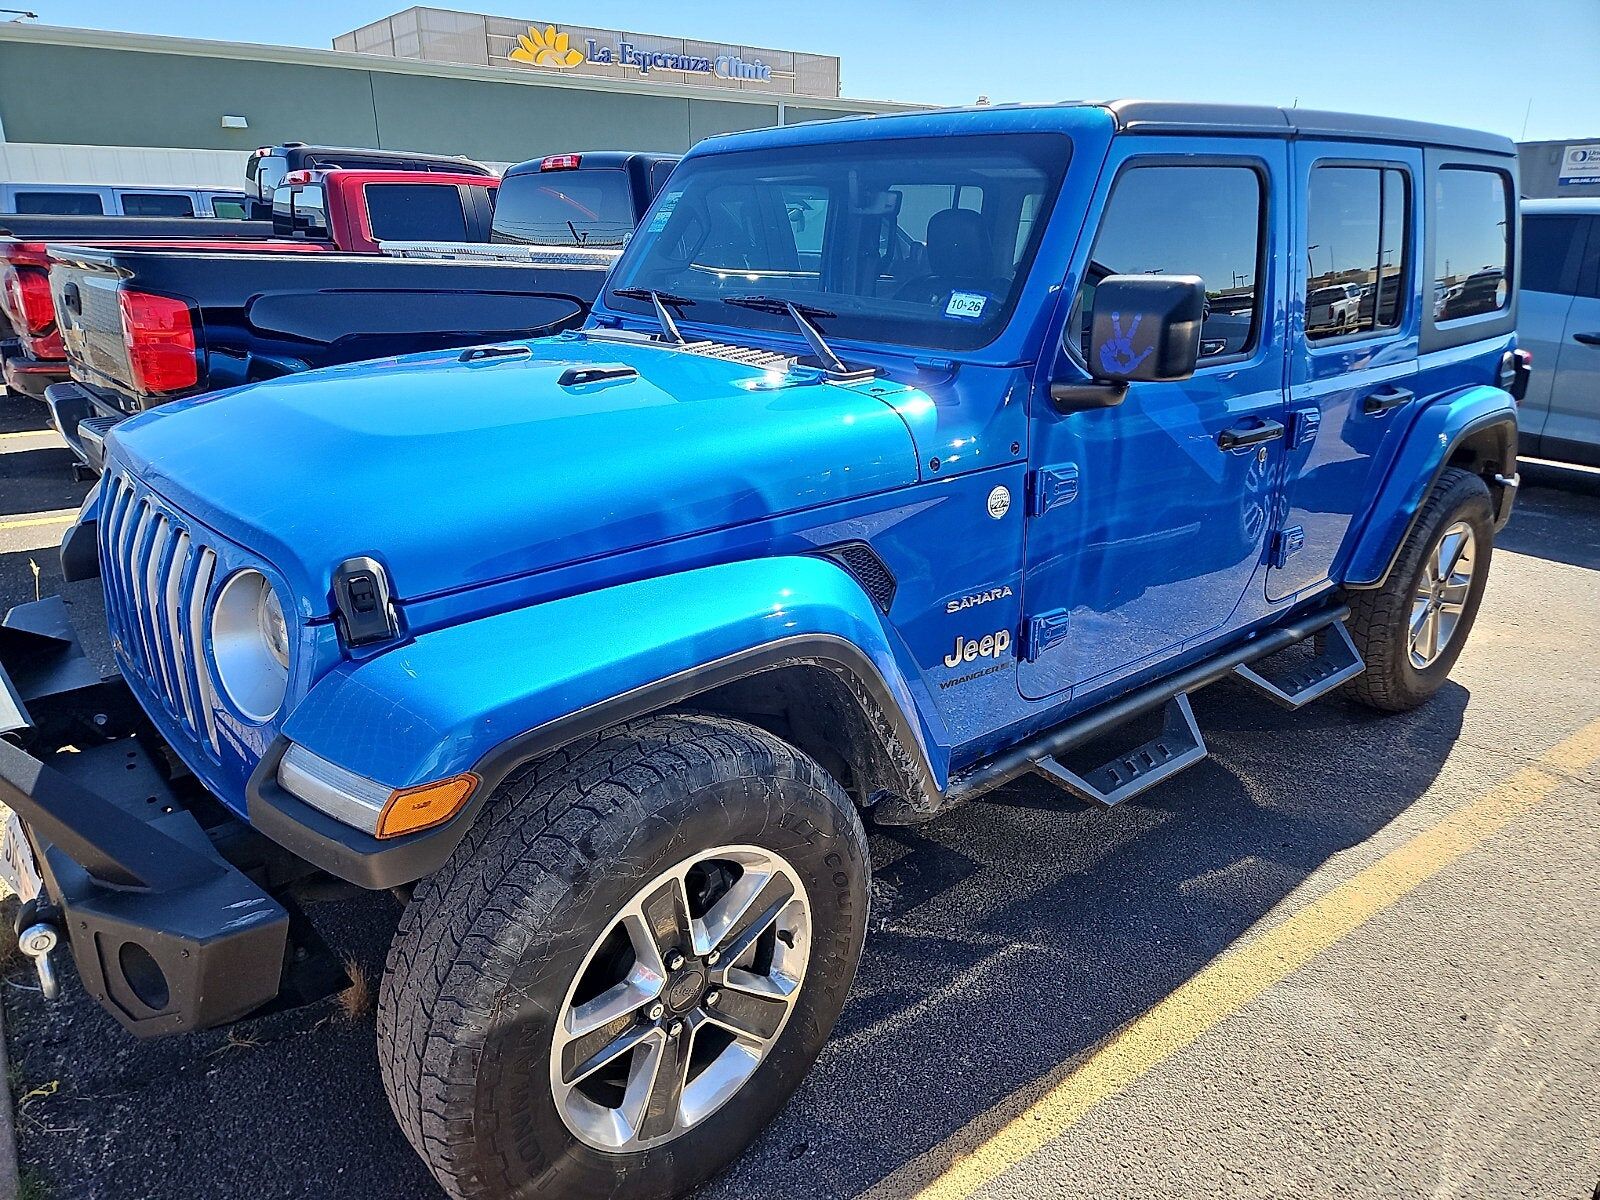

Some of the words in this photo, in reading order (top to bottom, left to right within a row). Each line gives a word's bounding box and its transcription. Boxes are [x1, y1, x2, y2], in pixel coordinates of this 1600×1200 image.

[586, 39, 613, 65] La
[714, 55, 773, 82] Clinic
[946, 586, 1013, 614] SAHARA
[944, 629, 1011, 668] Jeep
[940, 665, 999, 690] WRANGLER
